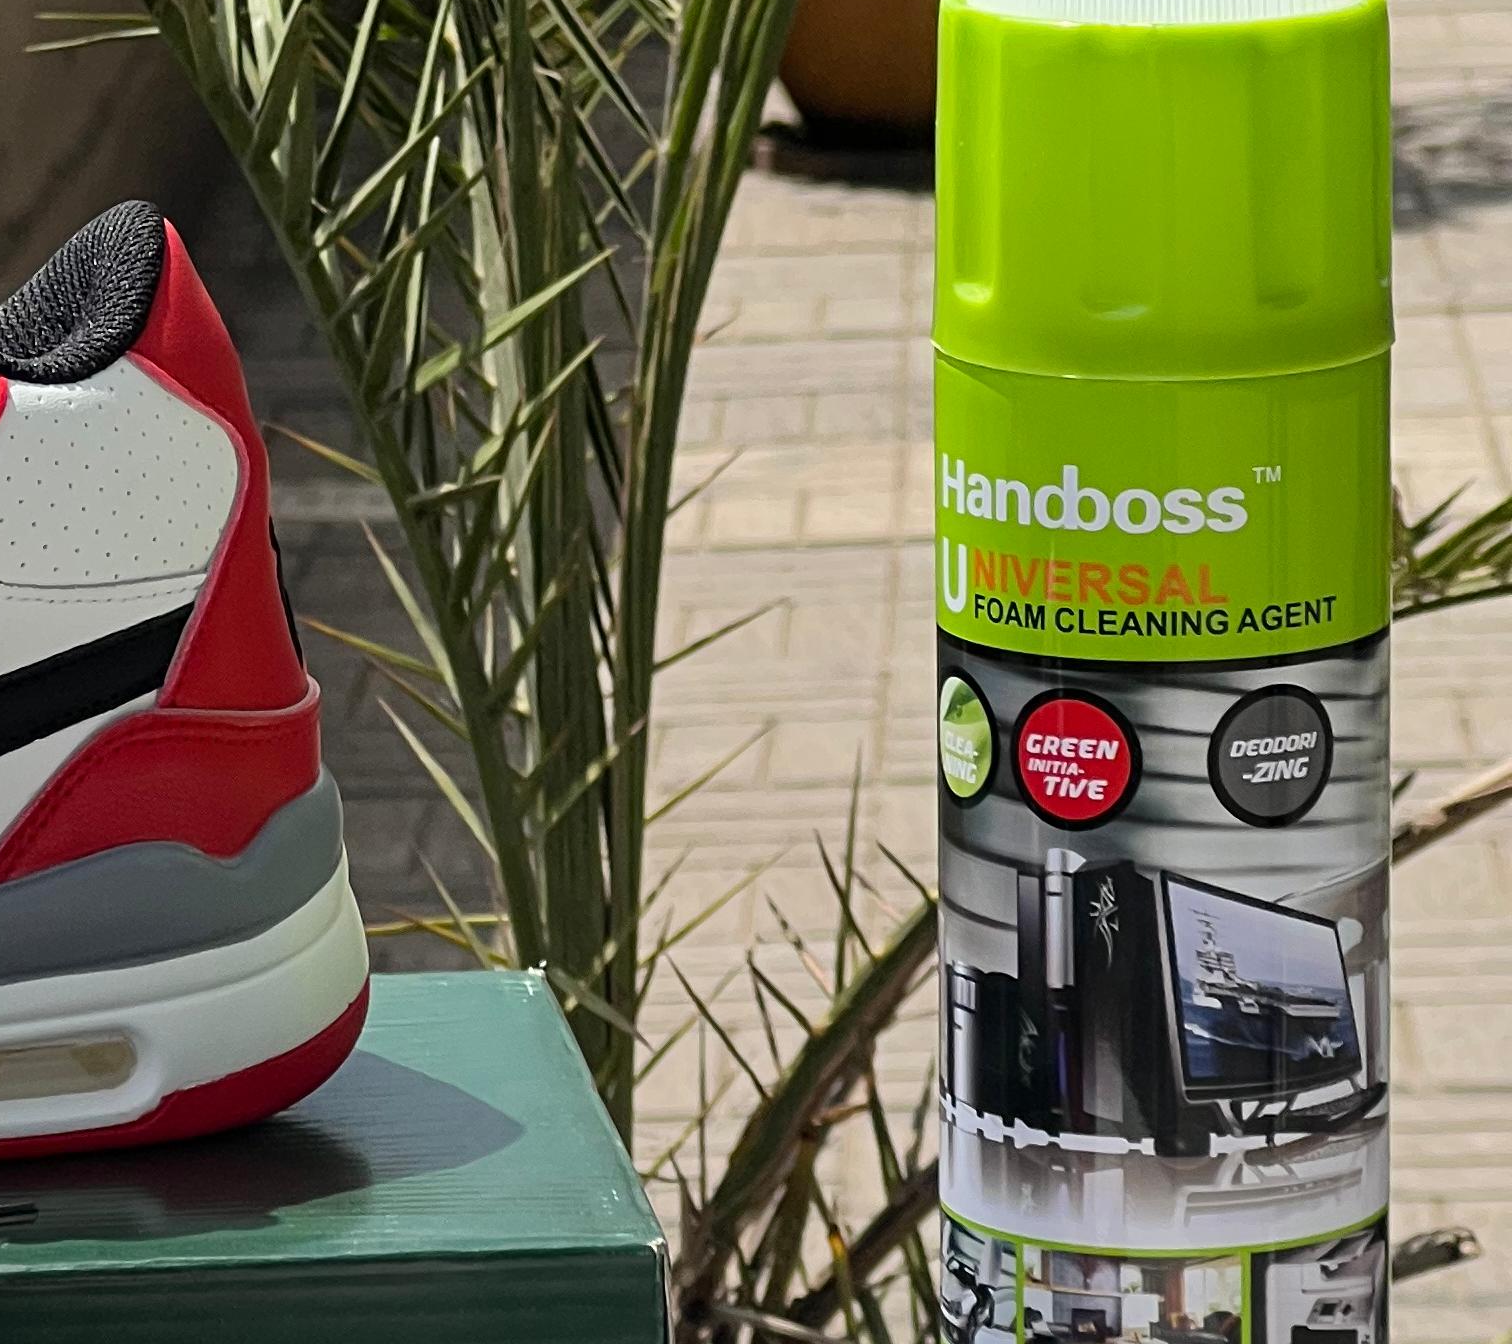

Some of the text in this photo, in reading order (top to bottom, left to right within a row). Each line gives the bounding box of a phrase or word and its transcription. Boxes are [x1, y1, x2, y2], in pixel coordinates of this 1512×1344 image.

[941, 453, 1248, 535] Handboss
[973, 594, 1338, 637] FOAM CLEANING AGENT
[1025, 733, 1119, 760] GREEN
[1230, 731, 1317, 759] DEODORI
[1028, 758, 1085, 775] INITIA-
[1241, 759, 1310, 784] -ZING
[1043, 776, 1109, 801] TIVE
